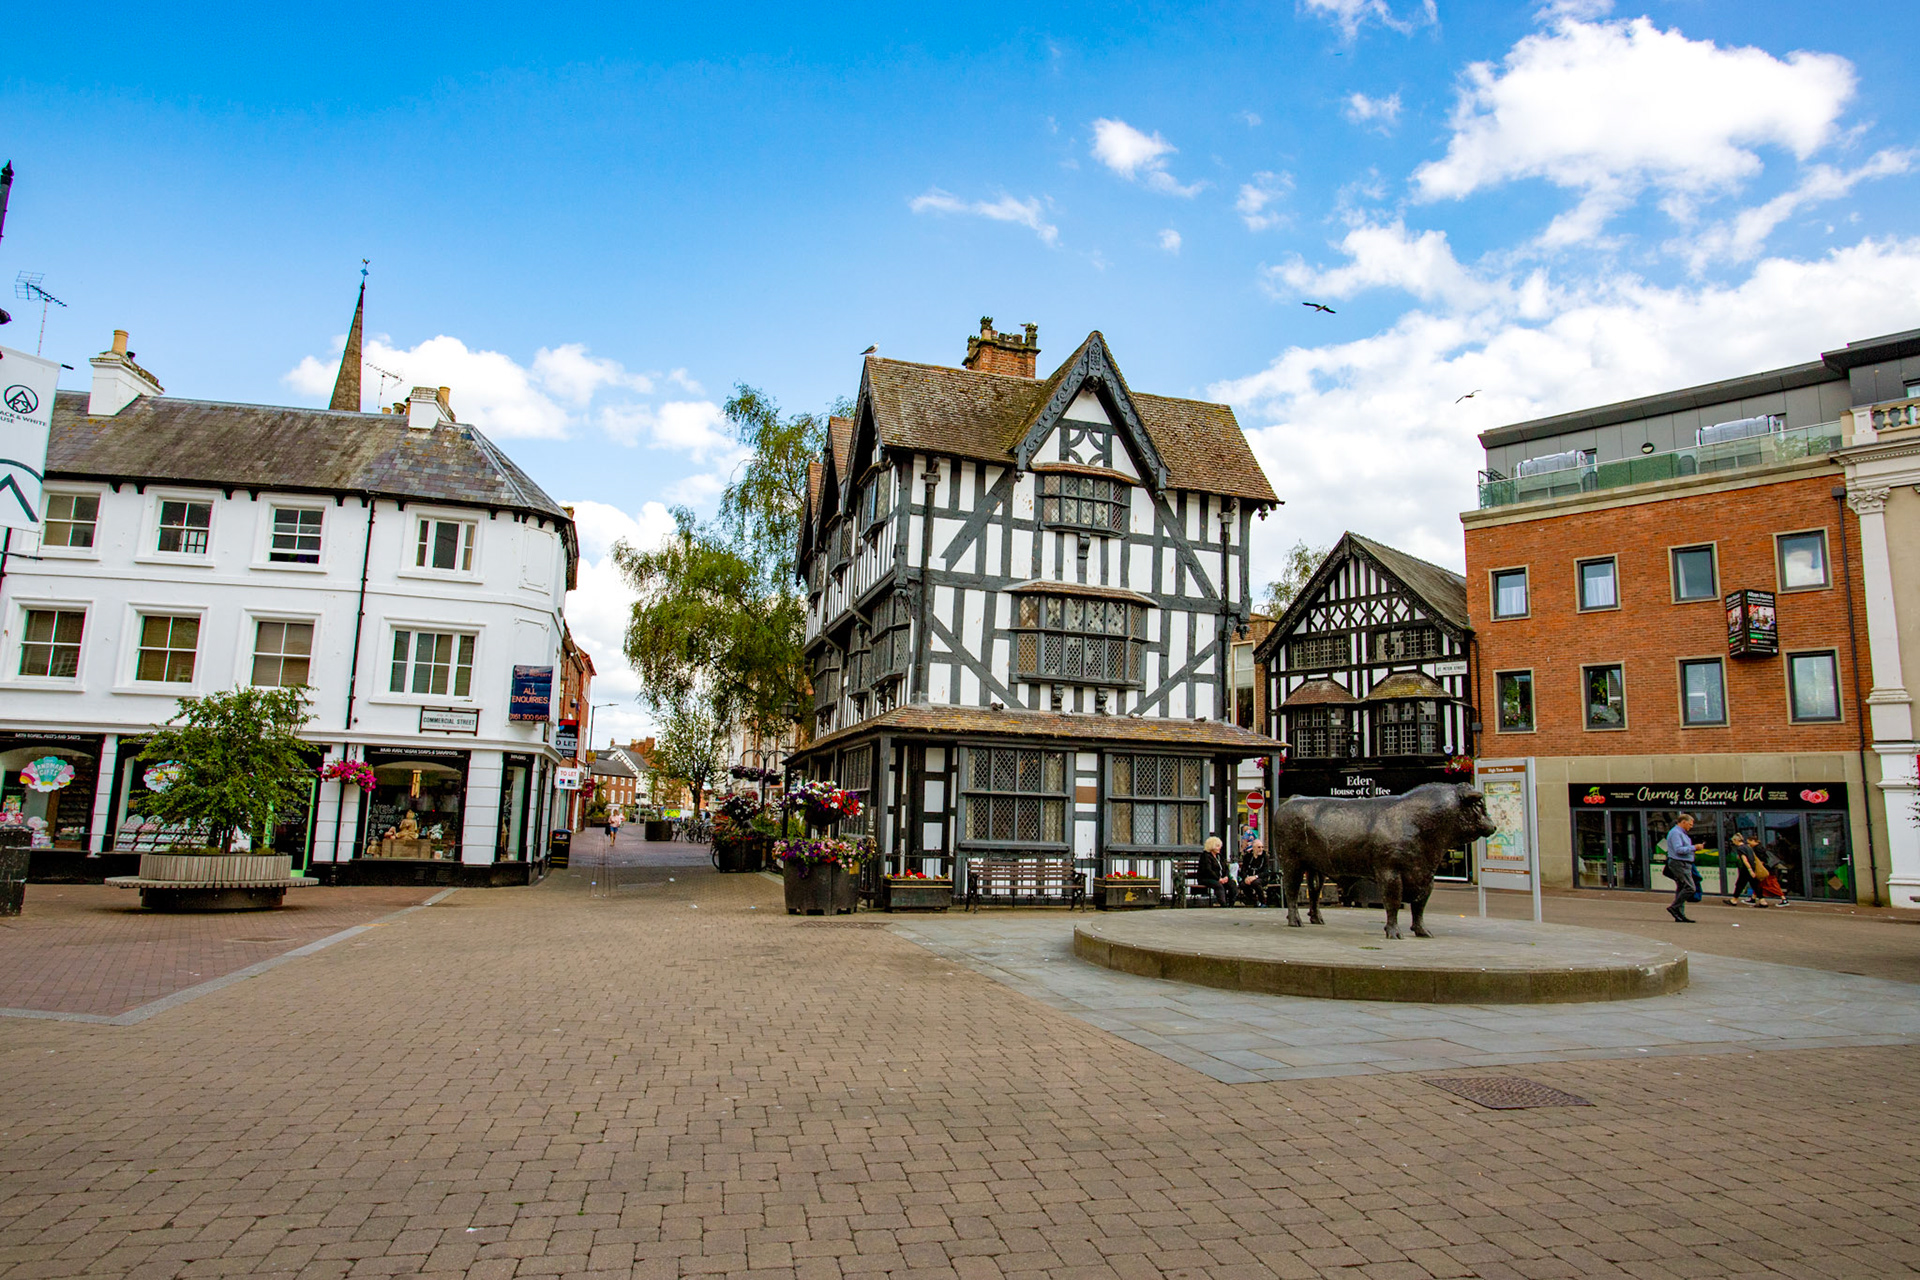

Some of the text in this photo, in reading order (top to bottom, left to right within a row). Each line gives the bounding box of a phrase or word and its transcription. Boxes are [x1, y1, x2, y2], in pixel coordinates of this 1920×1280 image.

[0, 410, 15, 418] ACK
[22, 416, 47, 427] WHITE
[0, 416, 15, 424] USE
[523, 687, 537, 695] ALL
[511, 695, 548, 704] ENQUIRIES
[423, 716, 476, 726] COMMERCIAL STREET
[1346, 775, 1373, 786] Eder
[1330, 787, 1391, 796] House of Cffee
[1637, 786, 1680, 801] Cherries
[1684, 787, 1695, 800] &
[1699, 786, 1739, 802] Berries
